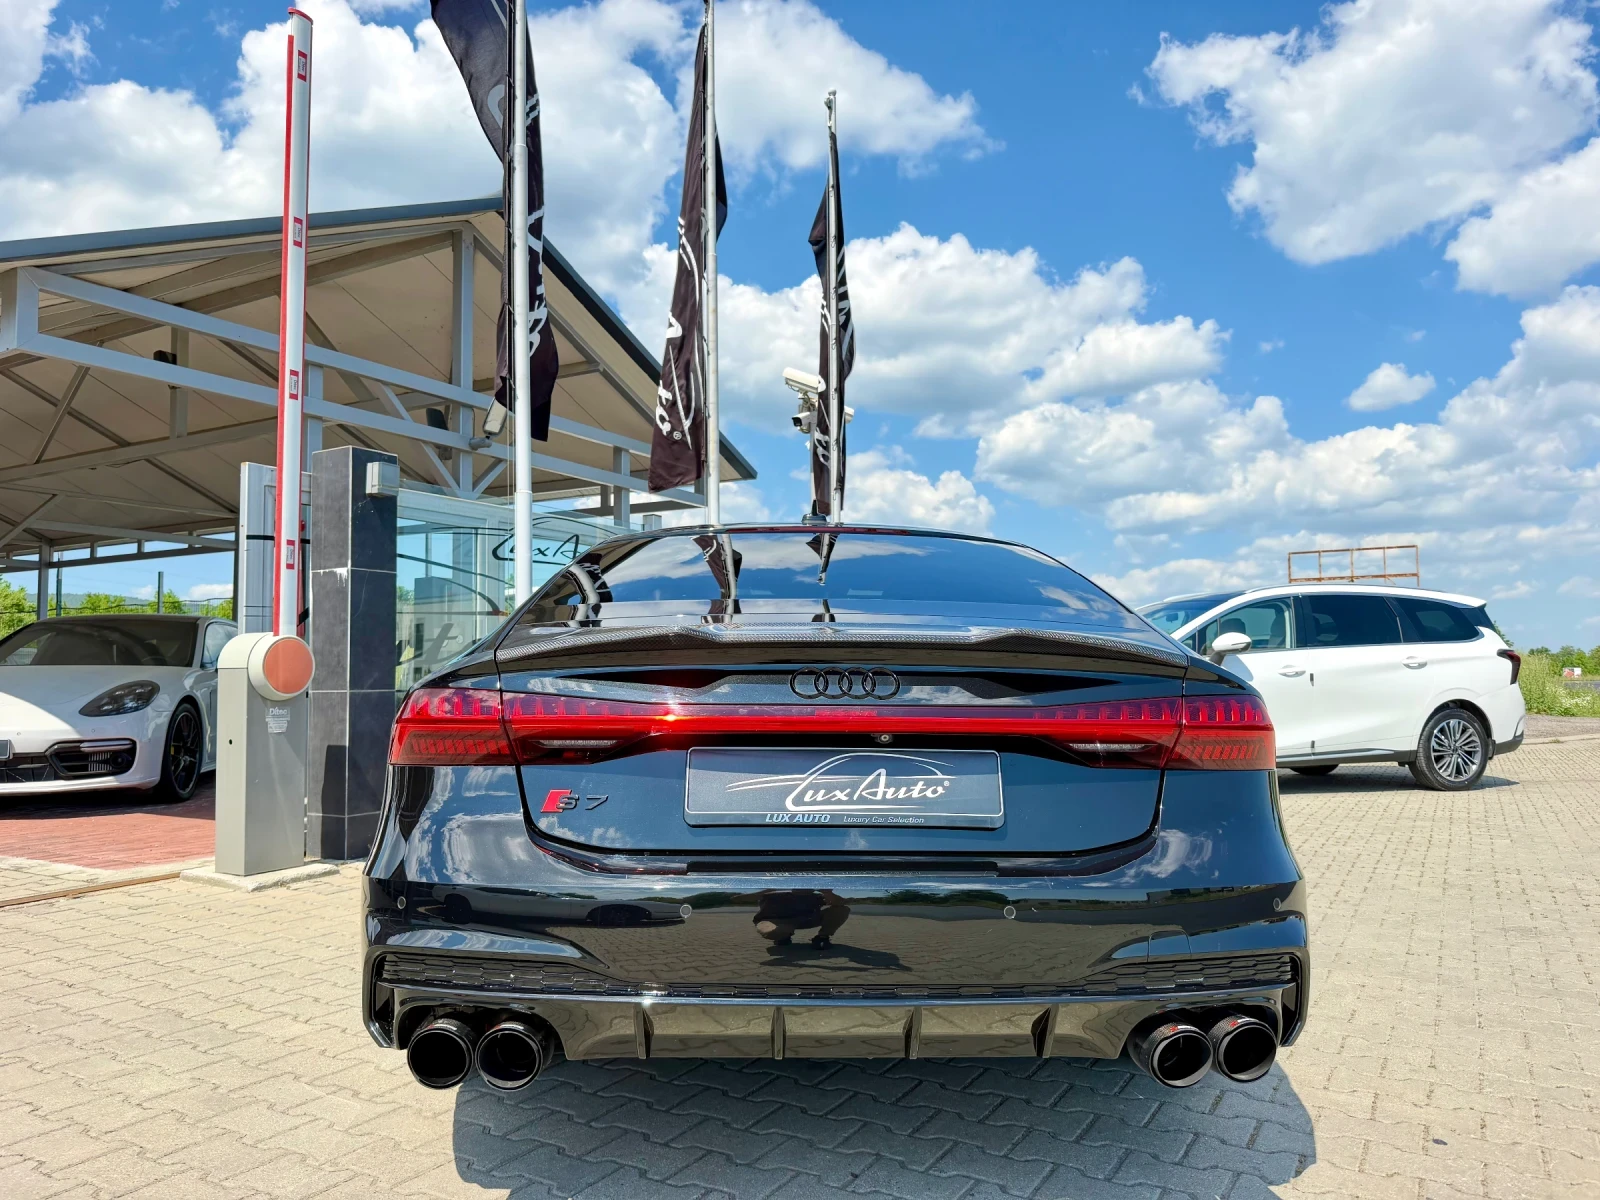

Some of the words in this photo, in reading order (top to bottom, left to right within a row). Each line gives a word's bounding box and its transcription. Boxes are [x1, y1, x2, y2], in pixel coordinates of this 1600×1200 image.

[555, 794, 609, 811] S7
[765, 813, 790, 823] LUX
[793, 814, 831, 823] AUTO
[843, 815, 870, 824] Luxury
[887, 816, 925, 824] Selection
